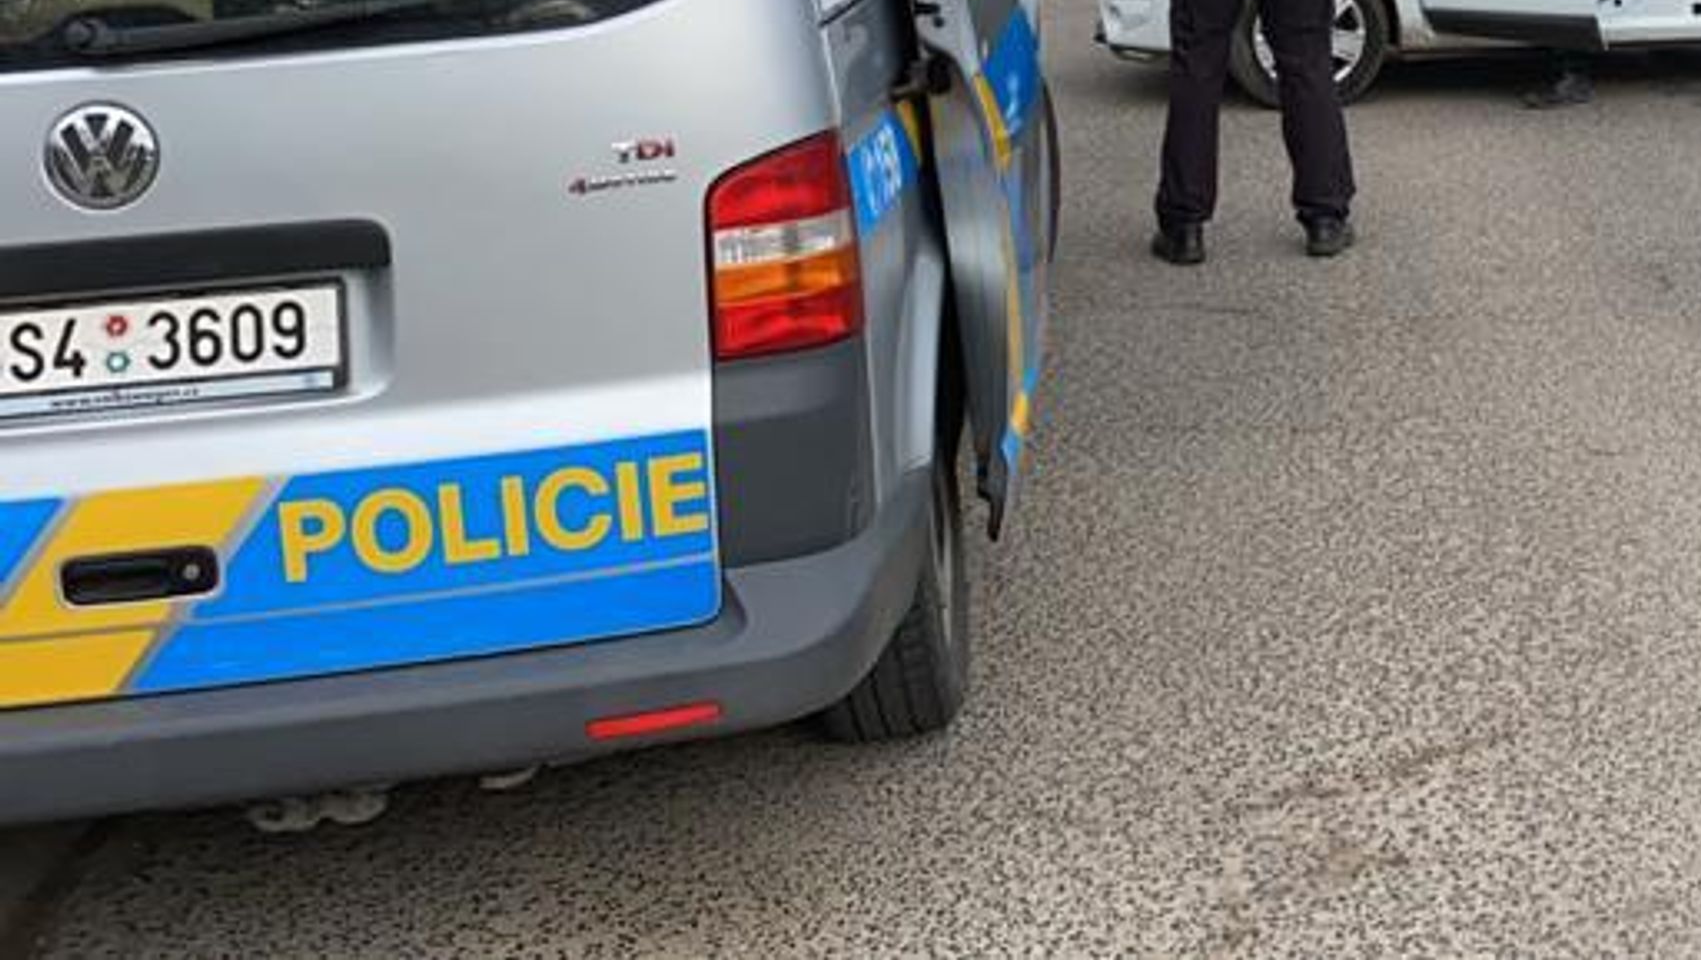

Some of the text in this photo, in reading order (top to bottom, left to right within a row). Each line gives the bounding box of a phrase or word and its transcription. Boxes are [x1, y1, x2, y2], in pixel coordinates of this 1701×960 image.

[9, 299, 307, 383] S4 3609
[278, 451, 711, 584] POLICIE
